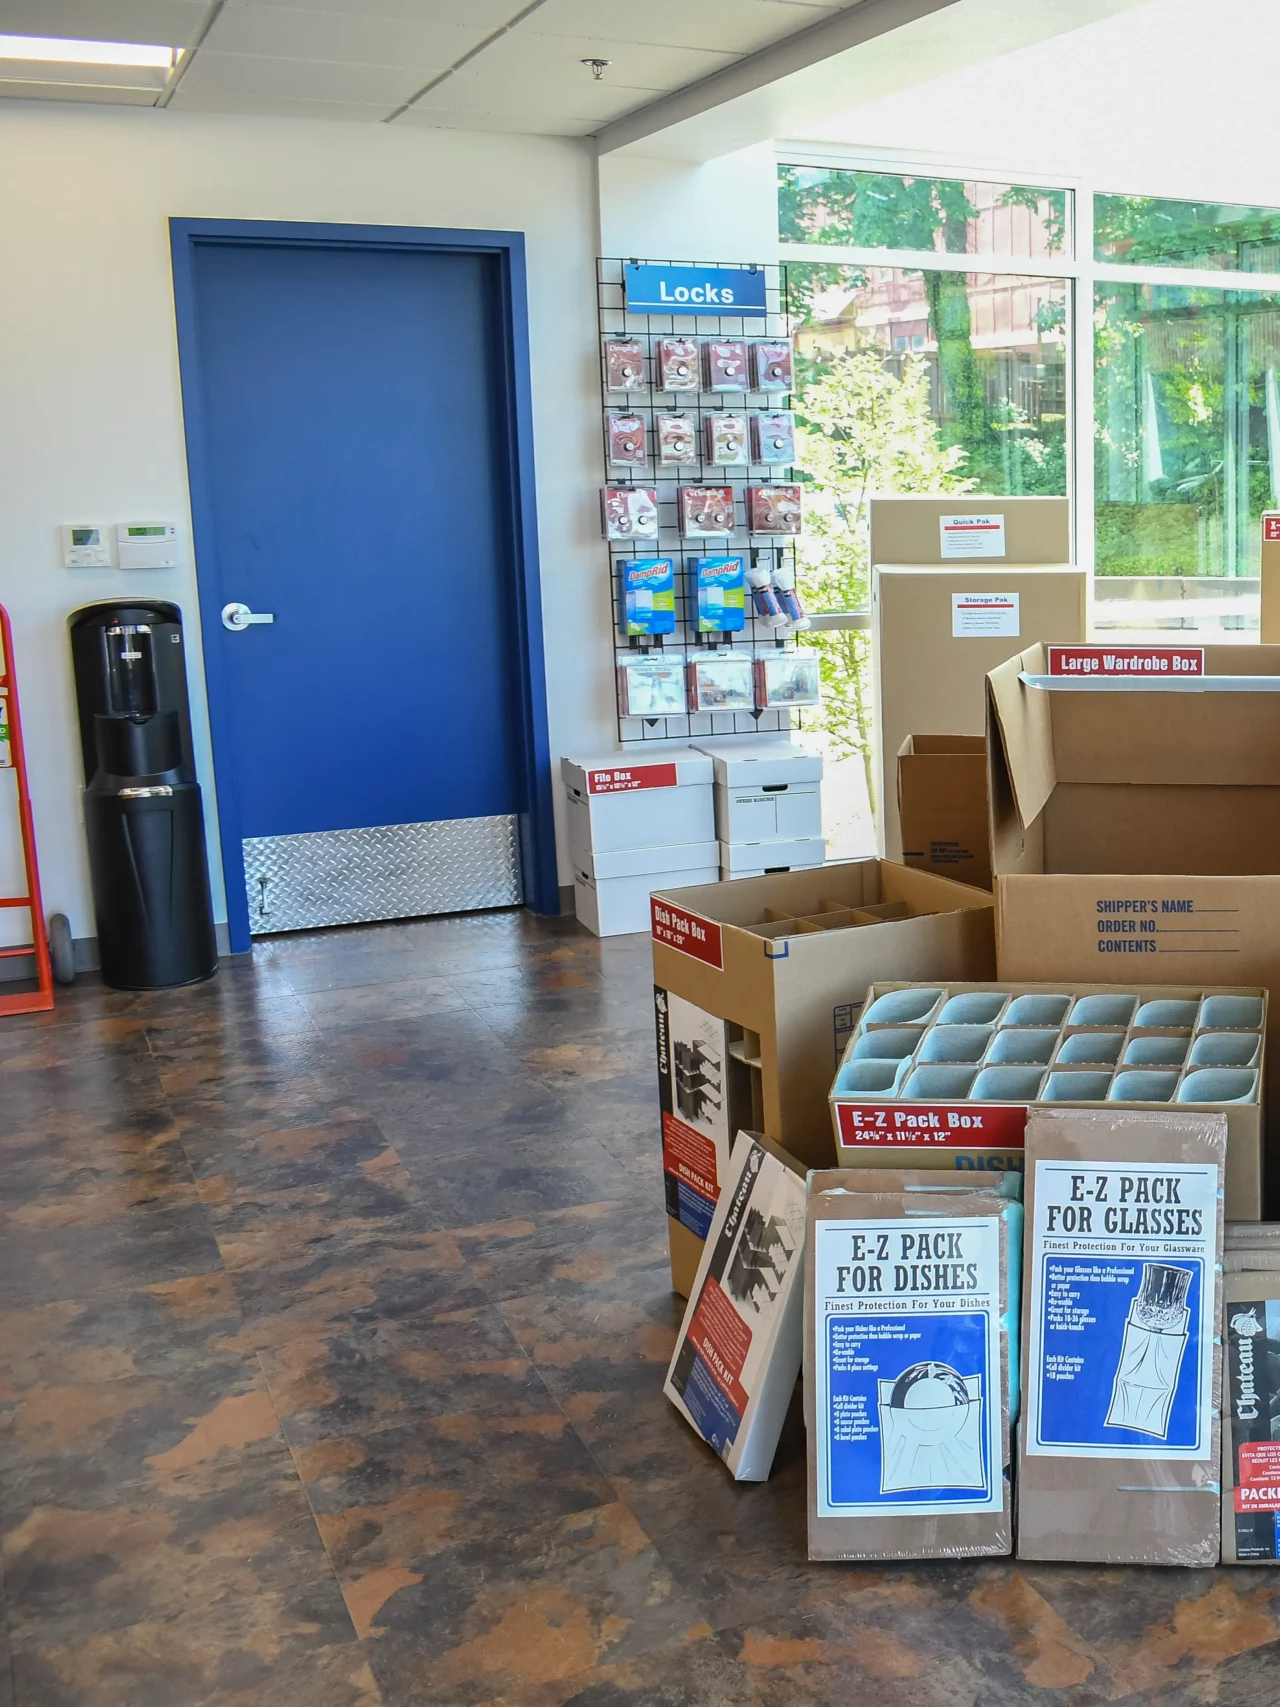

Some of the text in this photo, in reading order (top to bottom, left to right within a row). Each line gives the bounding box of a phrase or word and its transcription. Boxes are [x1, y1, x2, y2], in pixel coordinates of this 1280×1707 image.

[659, 281, 735, 304] Locks
[629, 563, 669, 580] DampRid
[702, 561, 739, 577] DampRid
[1061, 655, 1198, 672] Large Wardrobe Box
[594, 772, 631, 783] File Box
[1096, 900, 1194, 913] SHIPPER'S NAME
[655, 906, 706, 942] Dish Pack Box
[1097, 920, 1159, 933] ORDER NO.
[1098, 940, 1156, 953] CONTENTS
[659, 1013, 668, 1074] Chateau
[852, 1111, 983, 1129] E-Z Pack Box
[887, 1133, 893, 1141] x
[679, 1164, 713, 1194] DISH PACK KIT
[1070, 1175, 1181, 1204] E-Z PACK
[725, 1171, 752, 1237] Chateau
[1046, 1206, 1203, 1235] FOR GLASSES
[851, 1233, 963, 1261] E-Z PACK
[1043, 1241, 1205, 1253] Finest Protection For Your Glassware
[836, 1263, 978, 1292] FOR DISHES
[1051, 1290, 1061, 1299] Easy
[825, 1298, 990, 1311] Finest Protection For Your Dishes
[702, 1338, 734, 1385] DISH PACK KIT
[1237, 1336, 1259, 1421] Chateau
